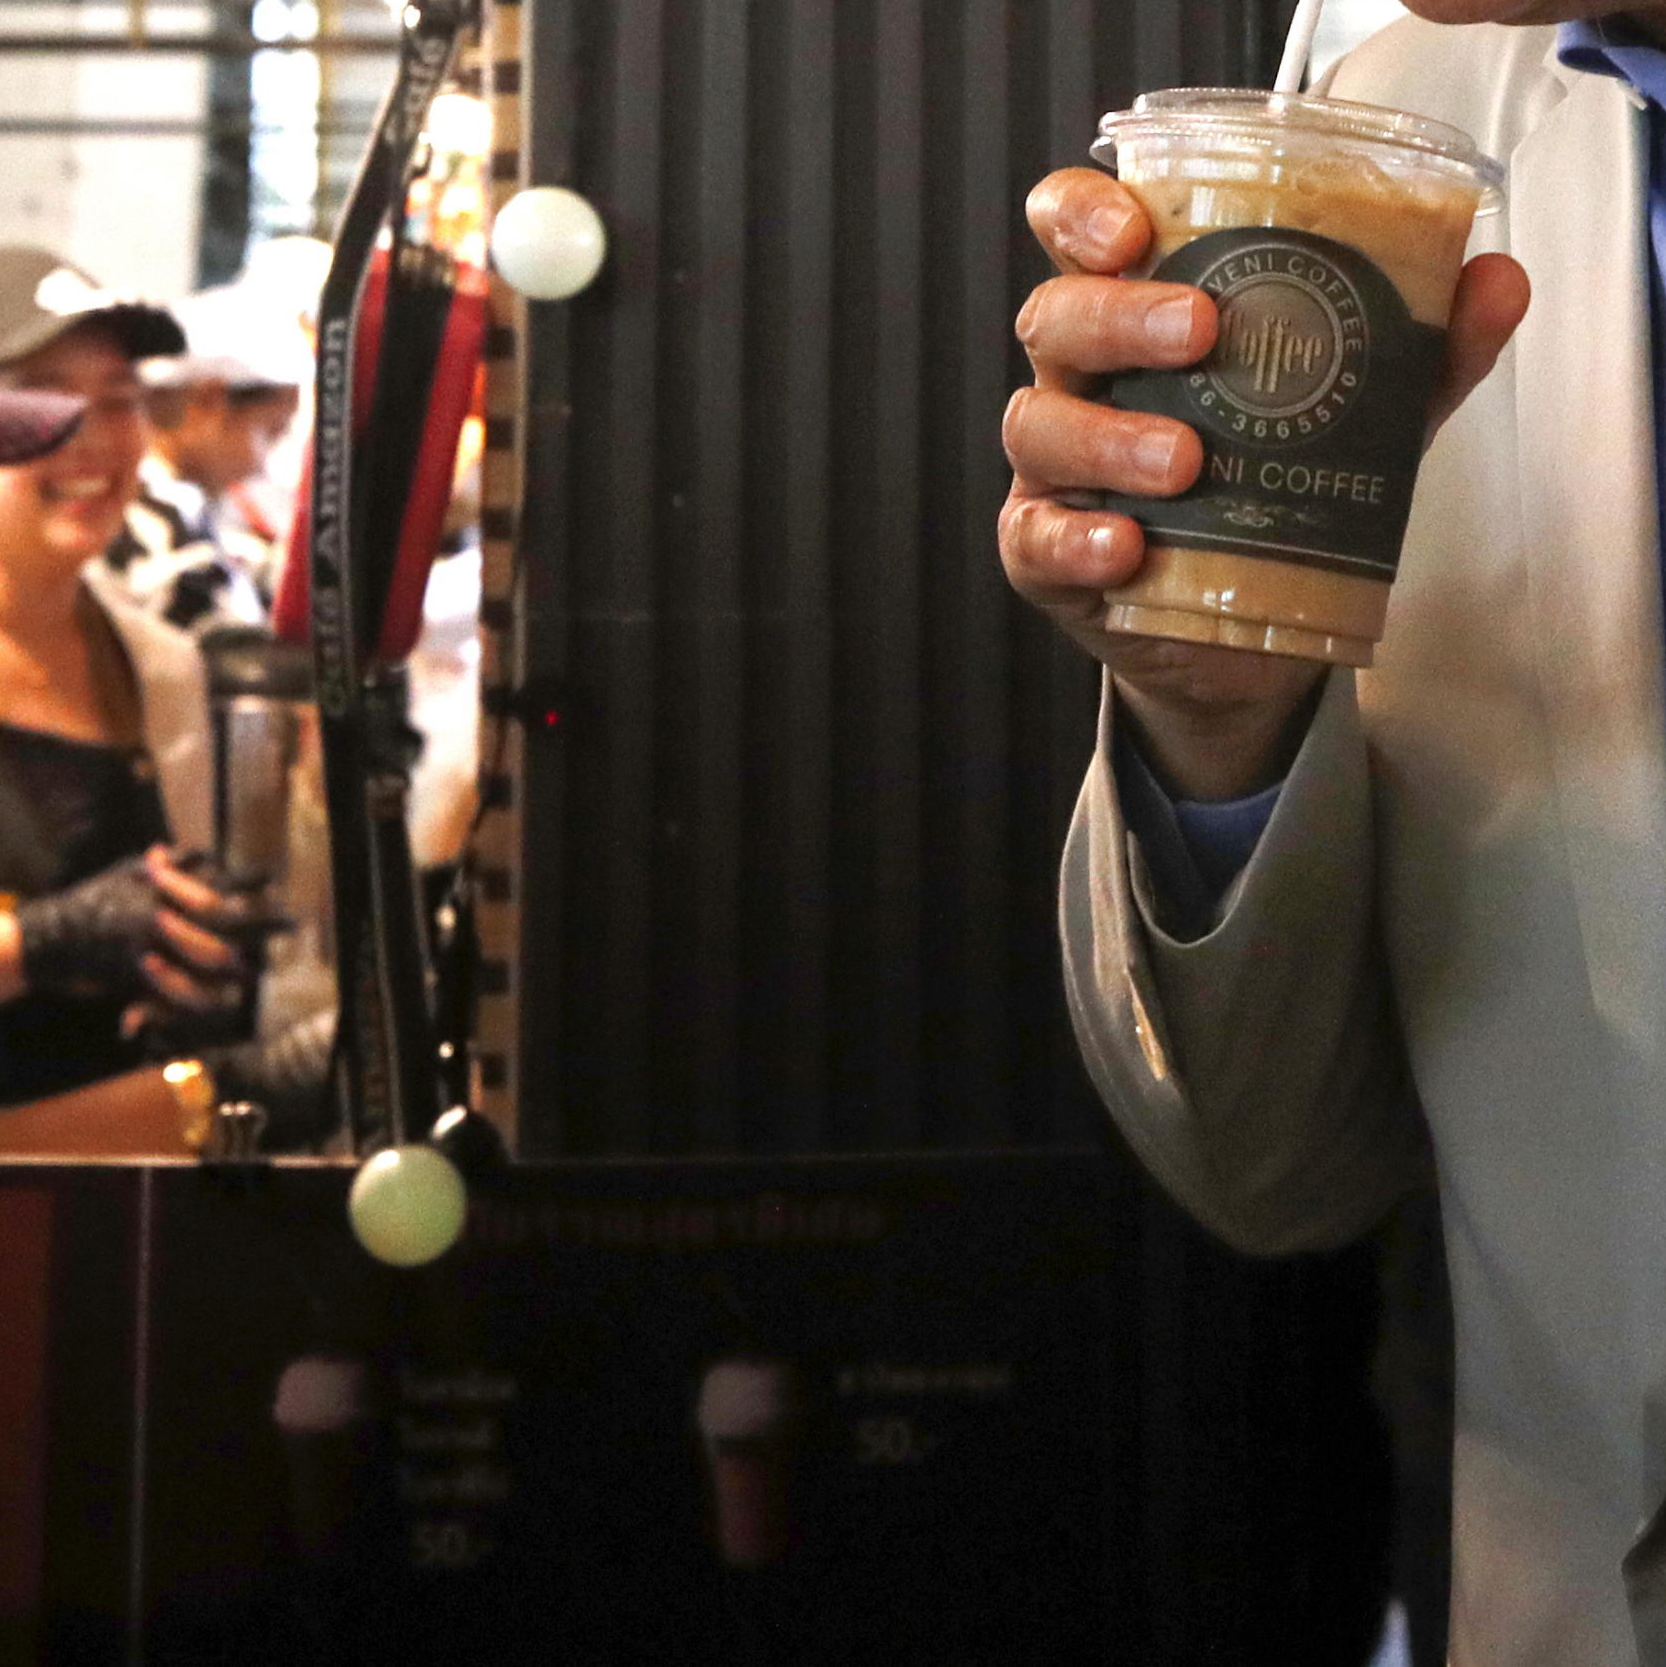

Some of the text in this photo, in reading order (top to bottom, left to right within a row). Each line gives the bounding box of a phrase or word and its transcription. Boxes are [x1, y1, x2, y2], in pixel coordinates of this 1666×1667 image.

[1286, 254, 1363, 352] COFFEE
[1210, 454, 1384, 504] NI COFFEE
